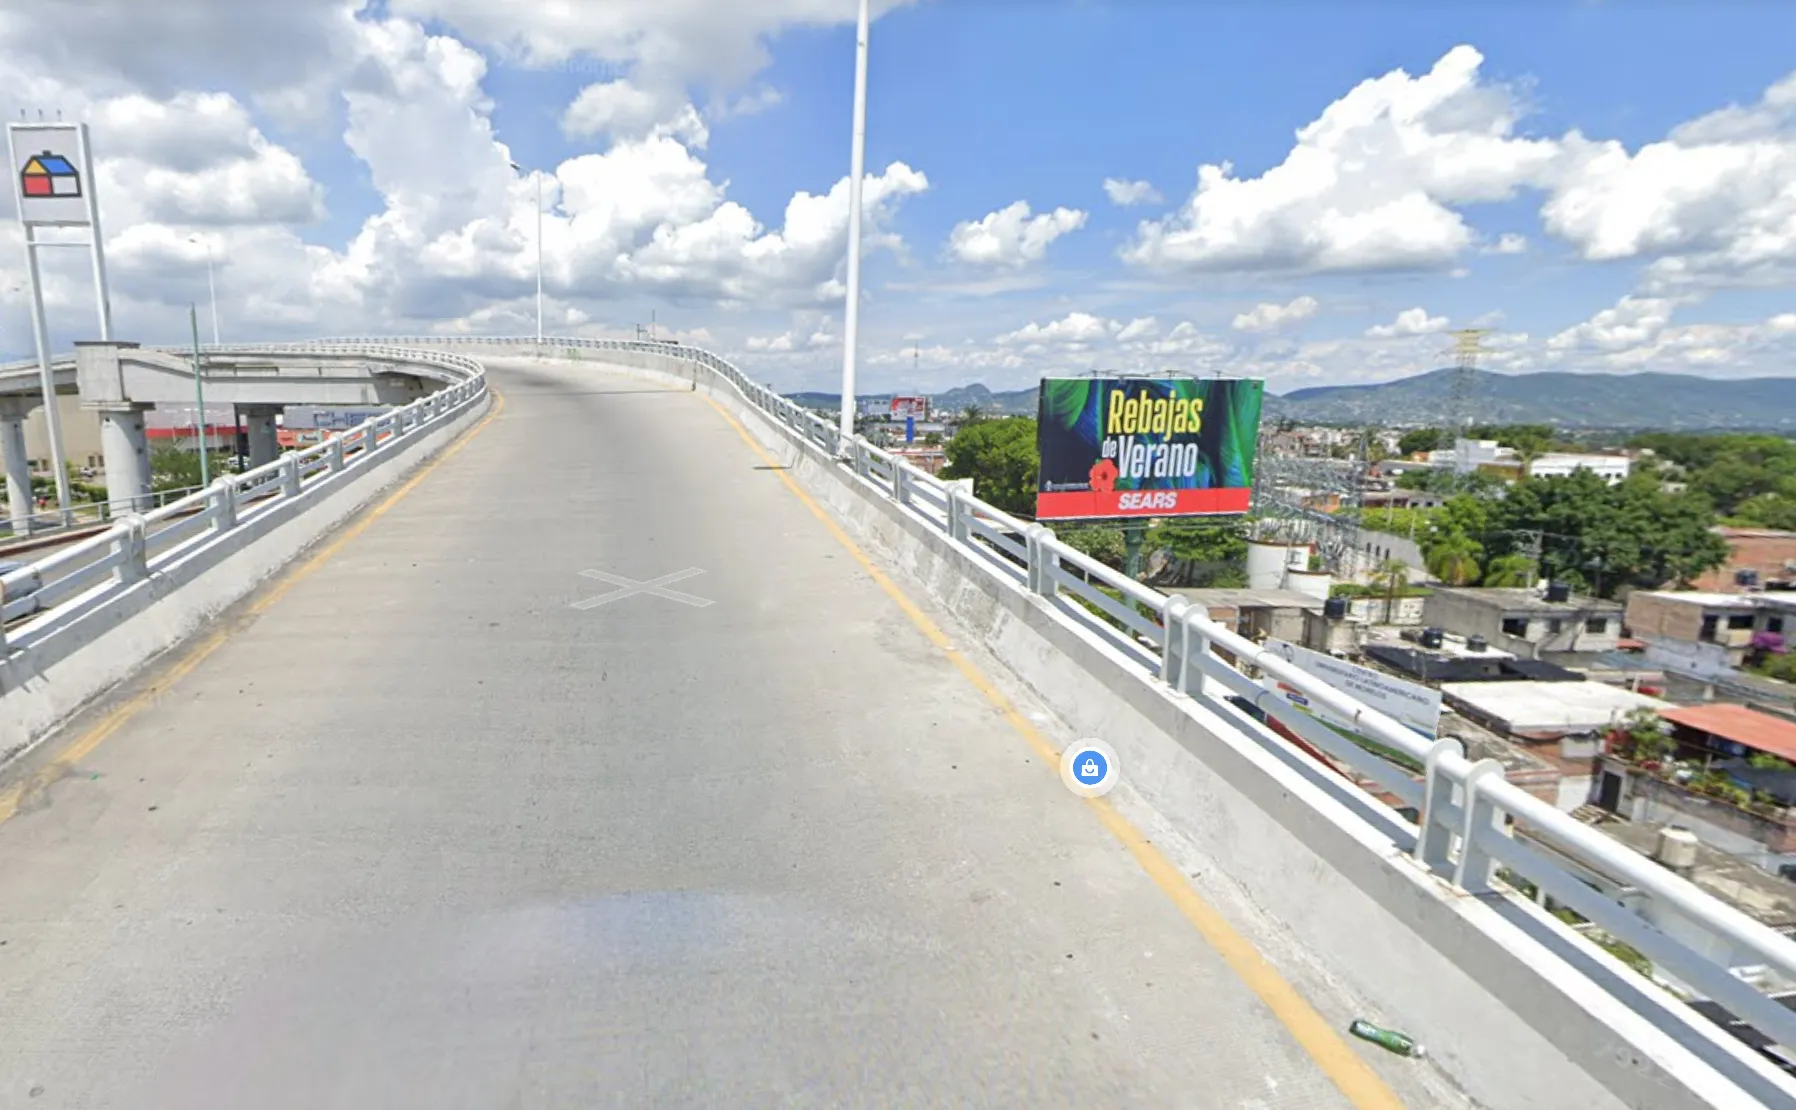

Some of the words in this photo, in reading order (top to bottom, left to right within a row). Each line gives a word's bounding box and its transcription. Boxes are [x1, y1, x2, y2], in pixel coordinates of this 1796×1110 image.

[1107, 389, 1204, 441] Rebajas
[1101, 435, 1117, 458] de
[1118, 434, 1199, 478] Verano
[1118, 492, 1178, 510] SEARS
